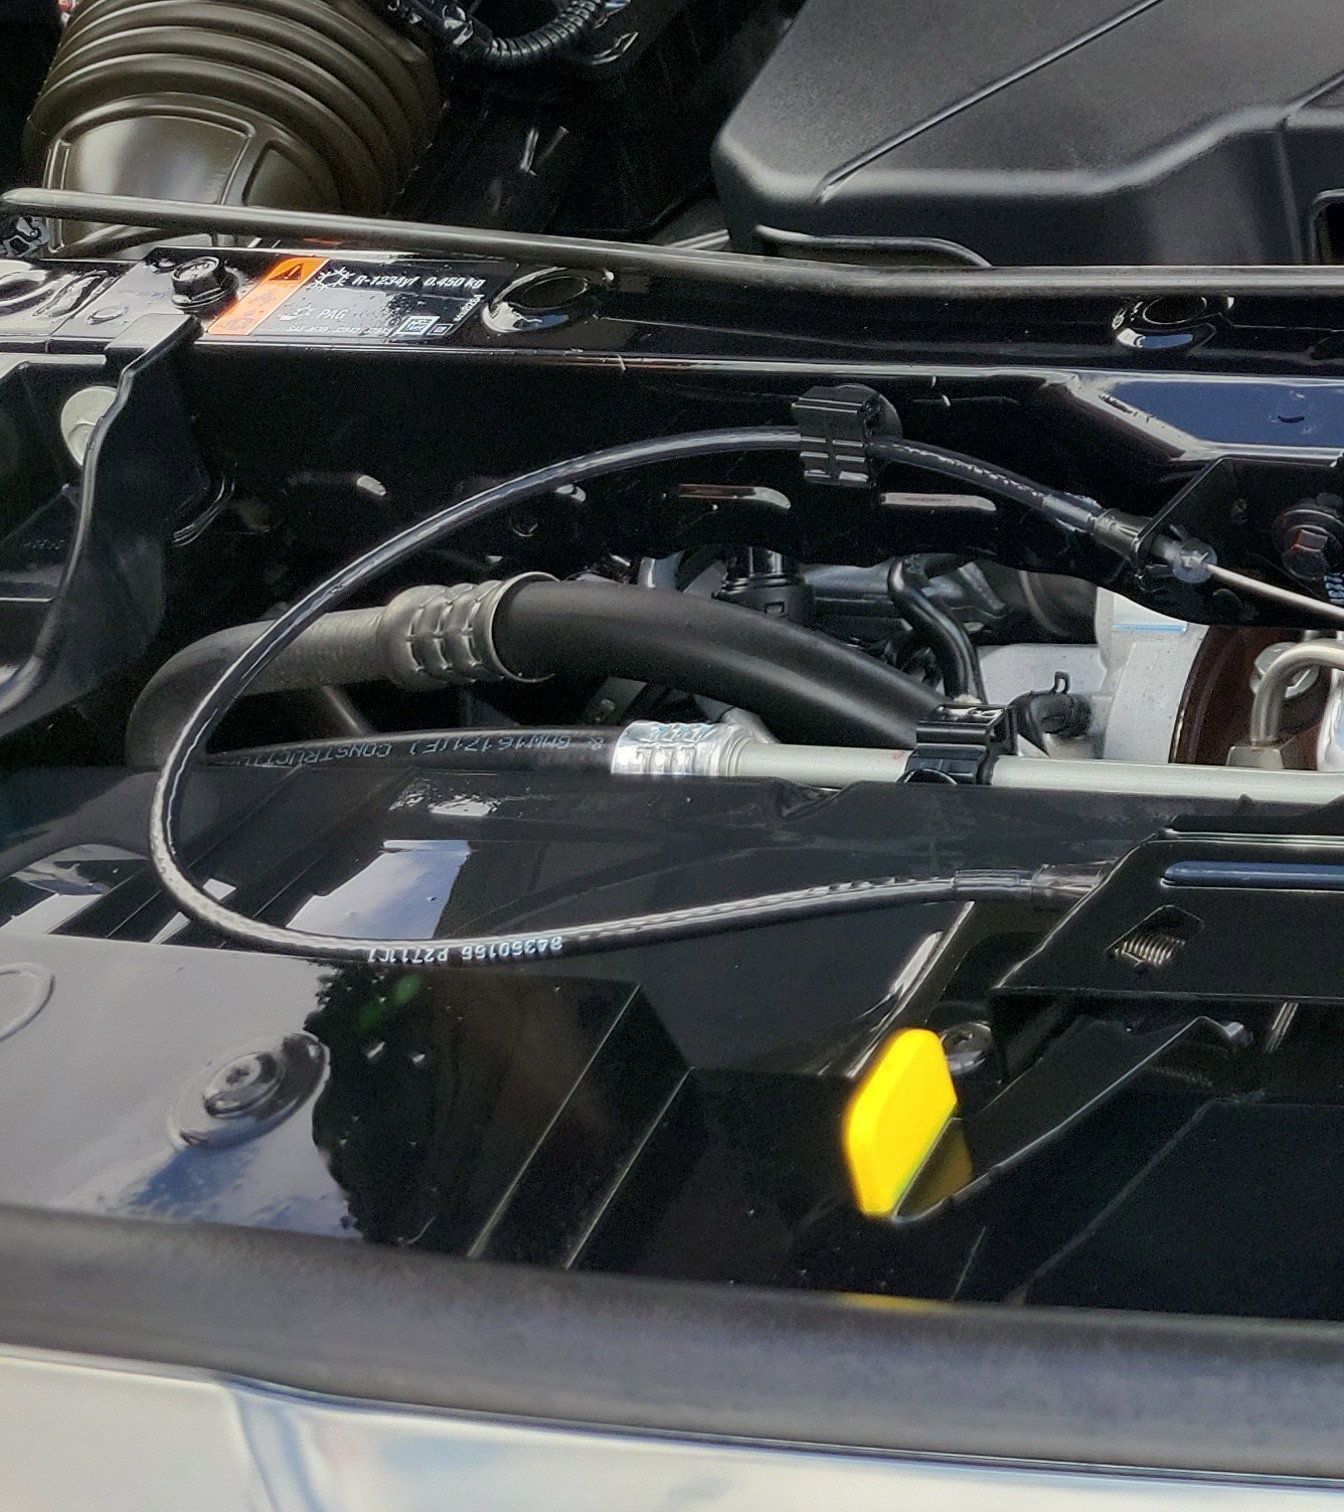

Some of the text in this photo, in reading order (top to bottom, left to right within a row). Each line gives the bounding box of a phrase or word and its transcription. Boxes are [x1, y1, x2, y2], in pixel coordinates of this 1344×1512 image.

[423, 275, 464, 289] 0.450
[464, 277, 487, 290] kg
[316, 309, 348, 320] PAG
